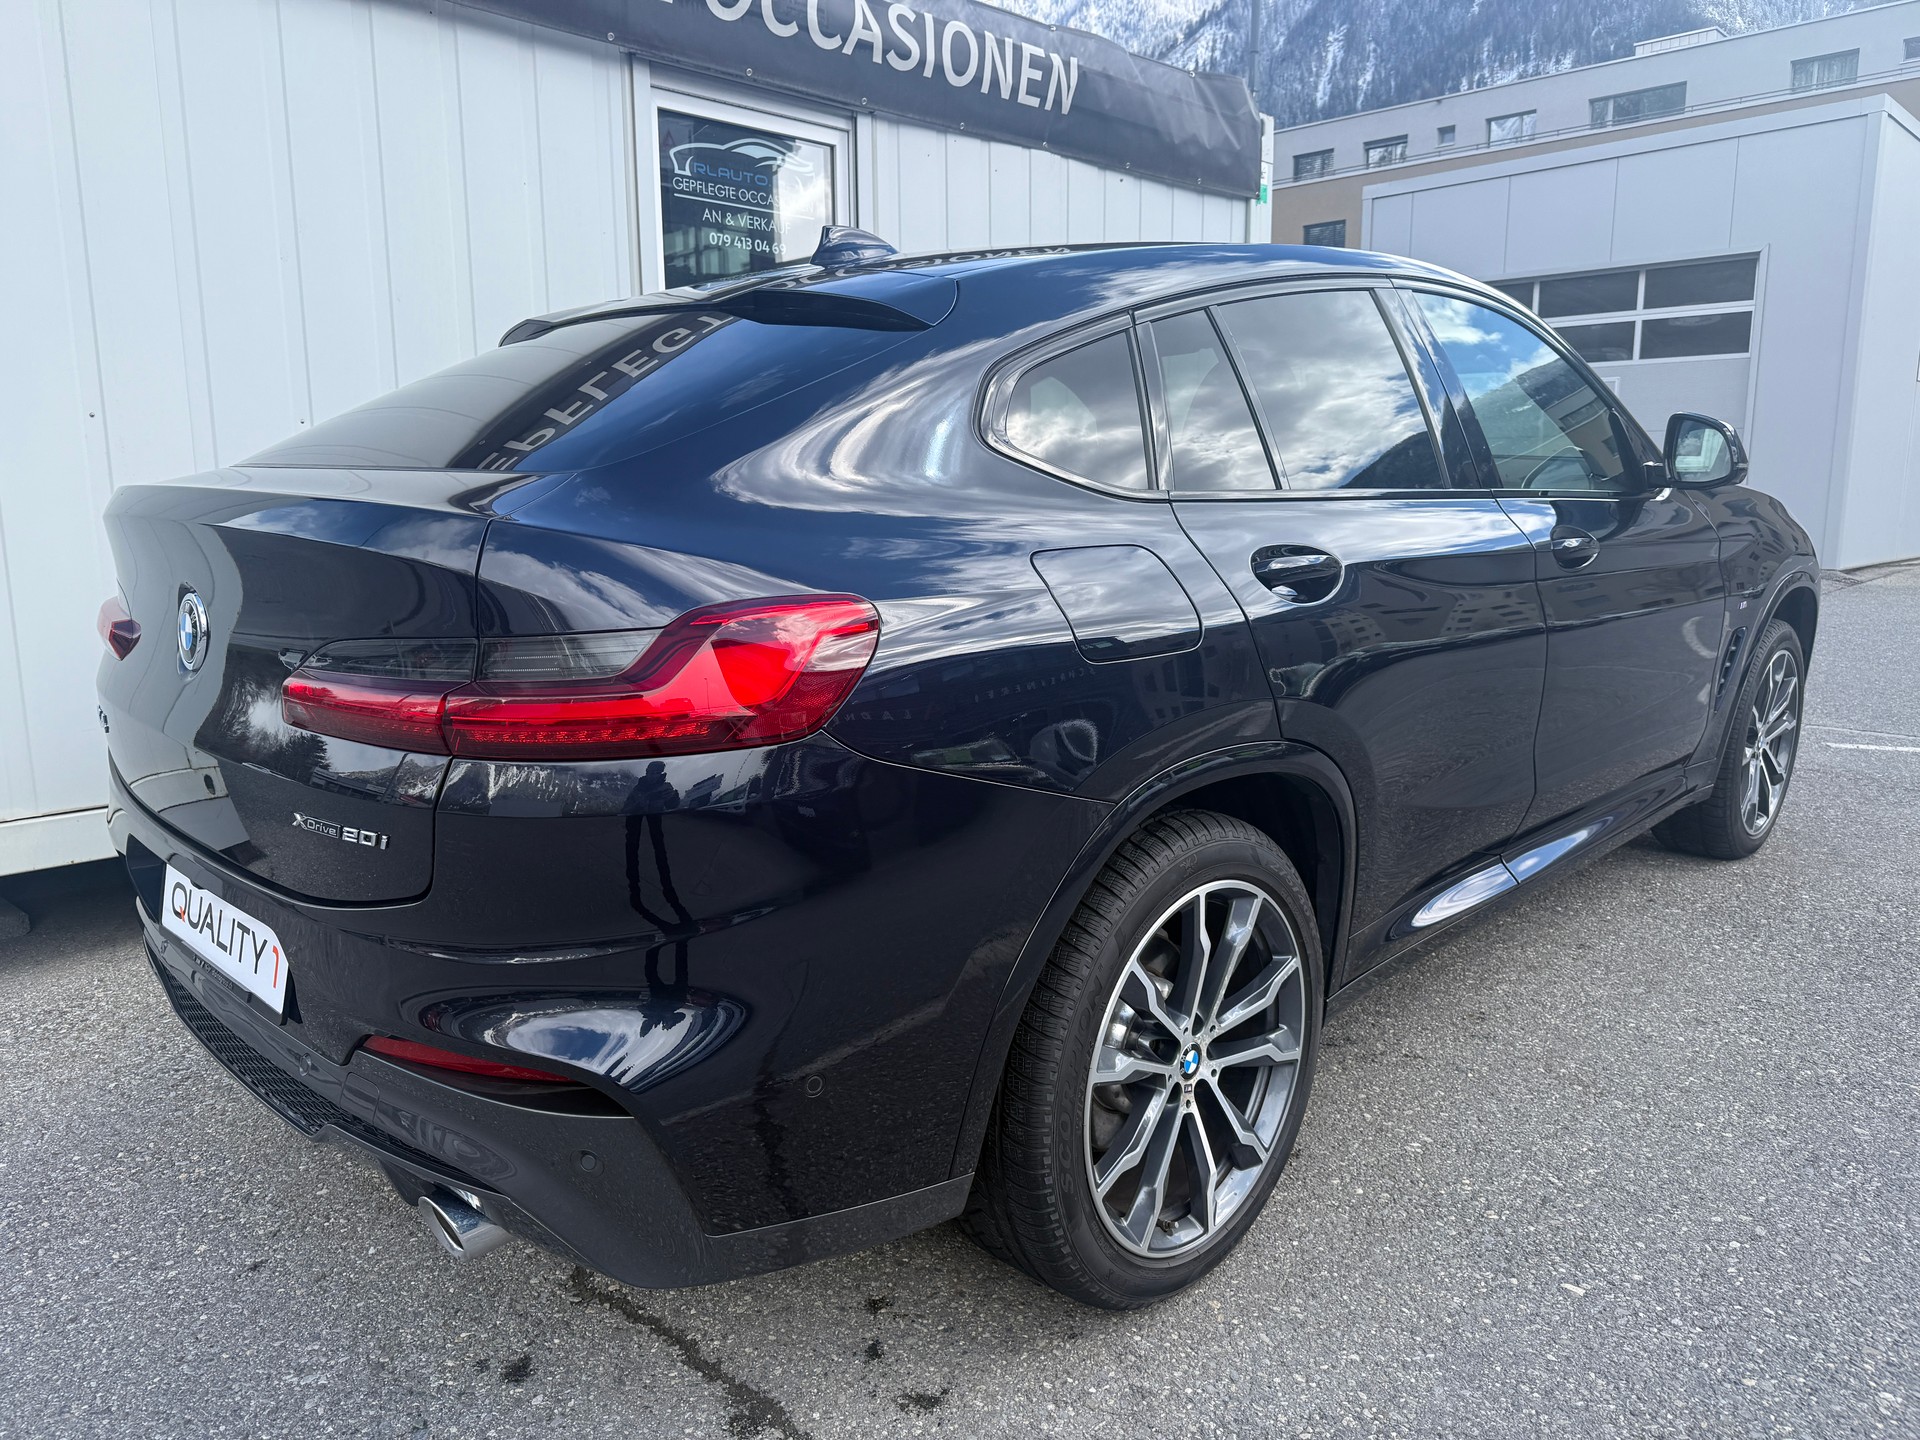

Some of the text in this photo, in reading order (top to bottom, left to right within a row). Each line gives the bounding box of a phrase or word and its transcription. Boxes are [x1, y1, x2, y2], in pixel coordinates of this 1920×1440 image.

[704, 0, 1078, 115] CCASIONEN
[672, 177, 736, 200] GEPFLEGTE
[702, 208, 792, 235] AN & VERKAUF
[709, 232, 787, 255] 079 413 04 69
[342, 826, 390, 850] 20i
